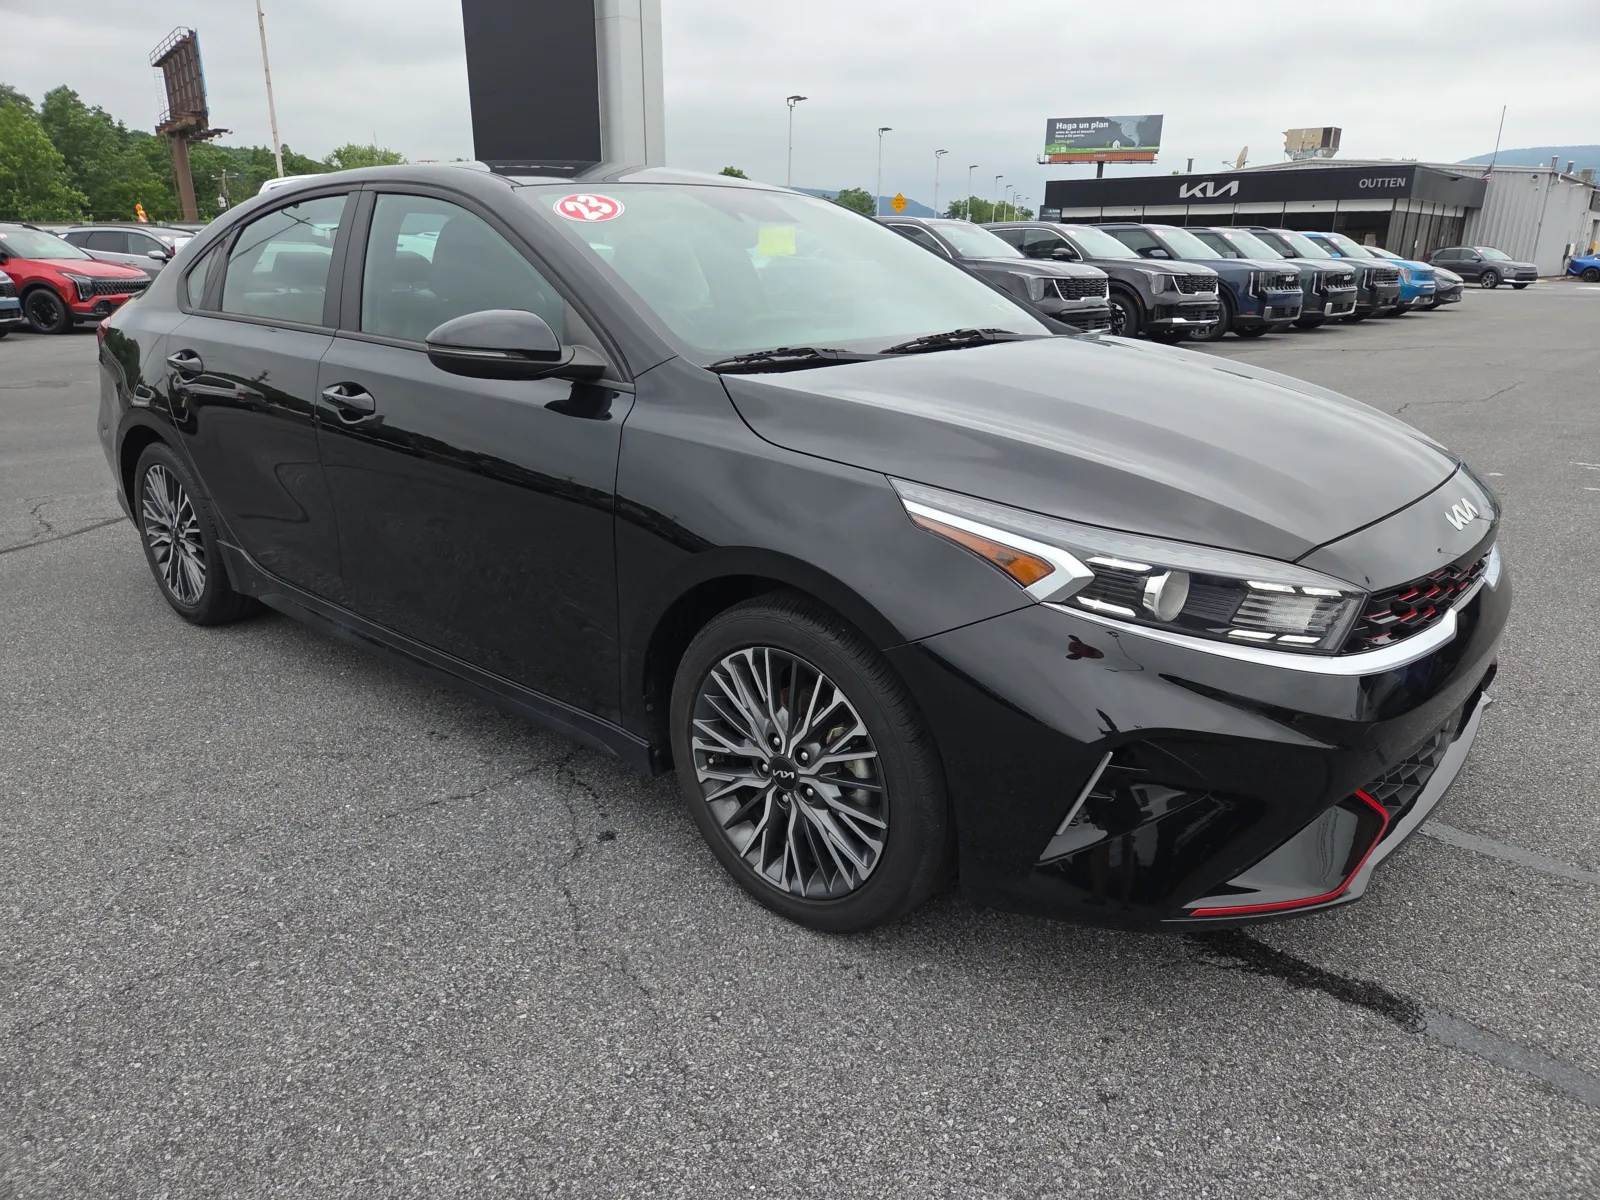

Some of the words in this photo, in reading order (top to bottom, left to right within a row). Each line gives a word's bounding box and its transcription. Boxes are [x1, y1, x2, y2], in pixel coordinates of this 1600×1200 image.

[1056, 122, 1077, 130] Haga
[1091, 121, 1109, 130] plan
[1179, 181, 1239, 198] KIA
[1359, 177, 1406, 188] OUTTEN
[564, 195, 613, 220] 23
[1444, 497, 1479, 531] KIA
